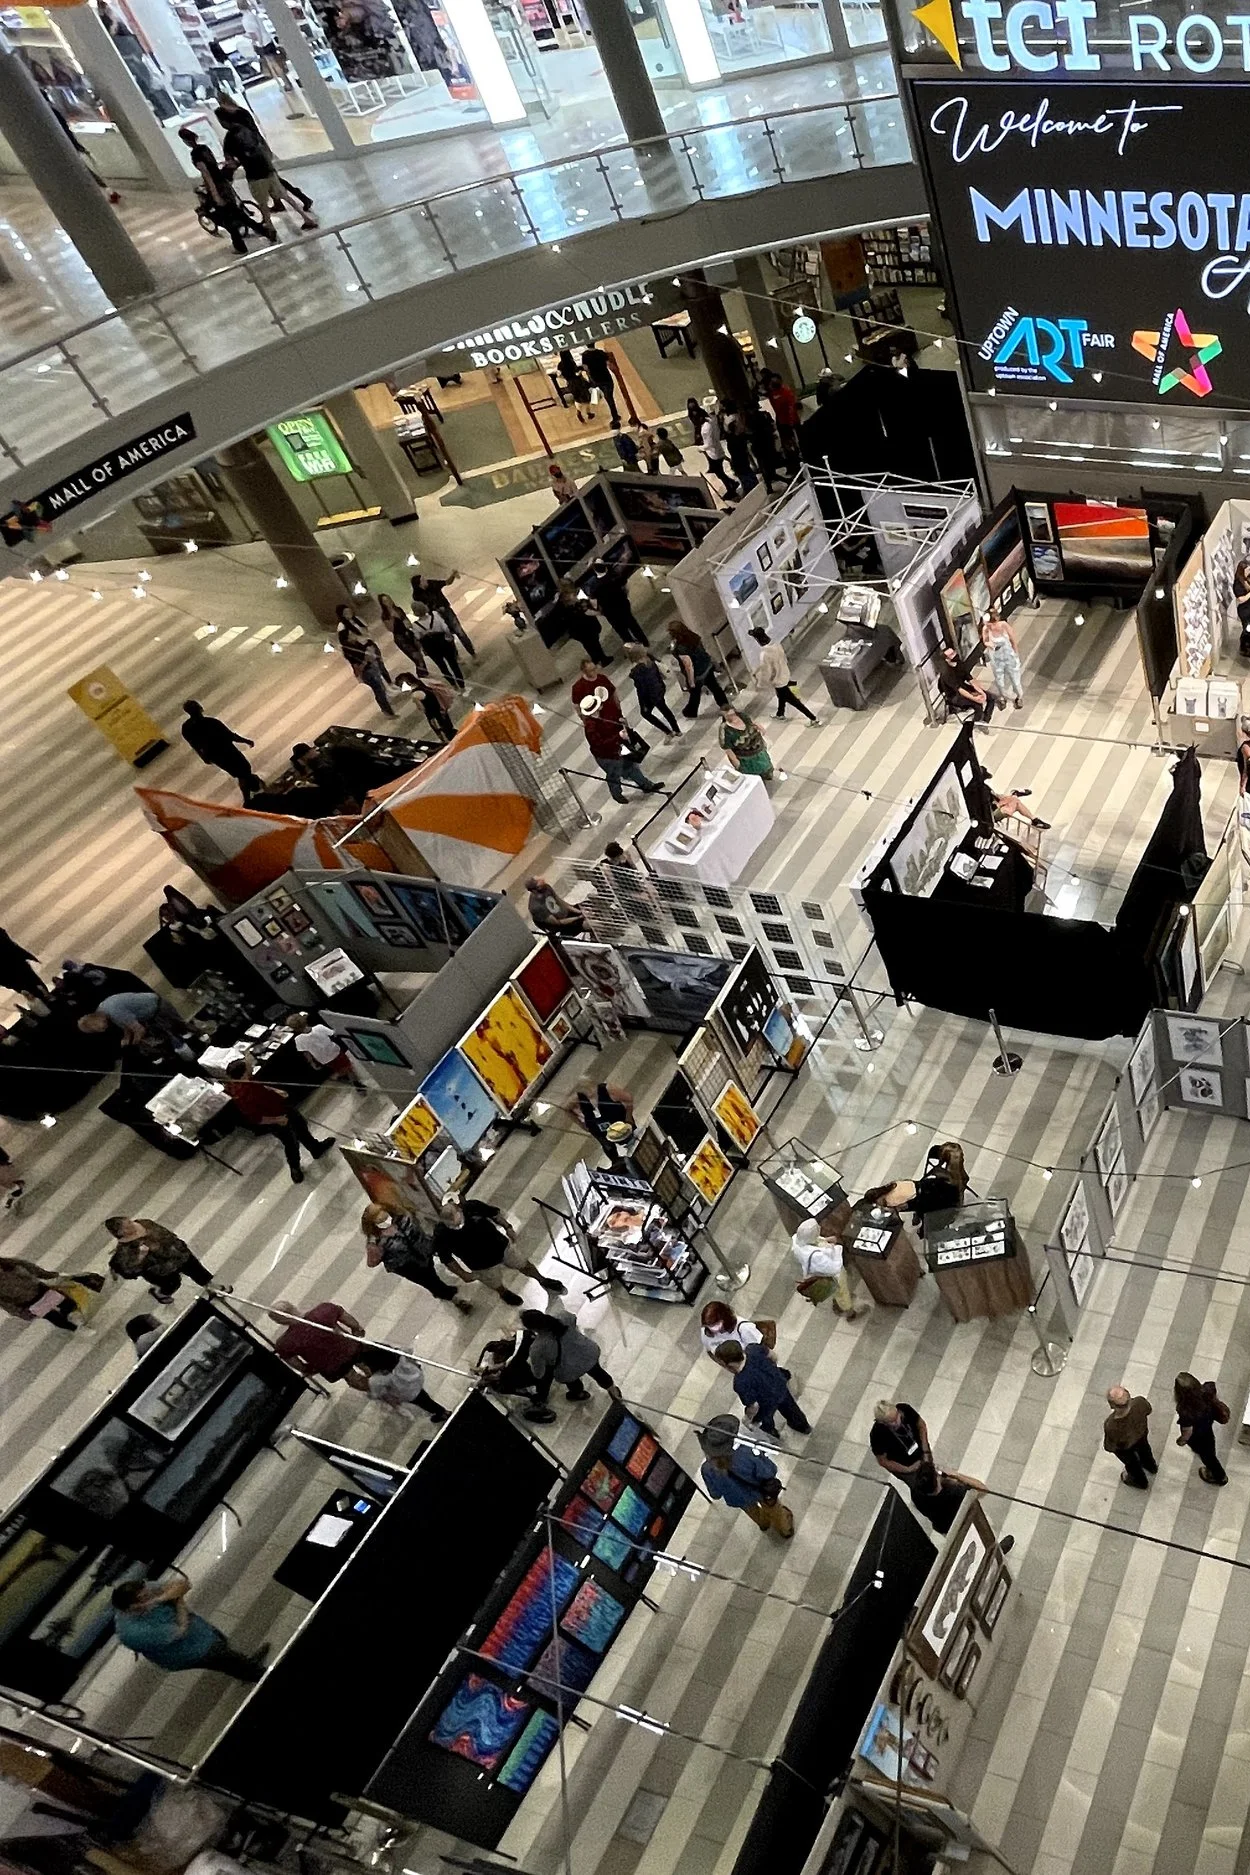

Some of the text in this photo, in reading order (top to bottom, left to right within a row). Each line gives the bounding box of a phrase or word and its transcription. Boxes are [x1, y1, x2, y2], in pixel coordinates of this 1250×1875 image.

[930, 96, 1183, 163] Welcome to
[470, 312, 642, 369] BOOKSELLERS
[978, 306, 1020, 362] UPTOWN
[994, 316, 1088, 384] ART
[1082, 332, 1115, 349] FAIR
[1152, 313, 1175, 386] MALL OF AMERICA
[48, 424, 188, 510] MALL OF AMERICA
